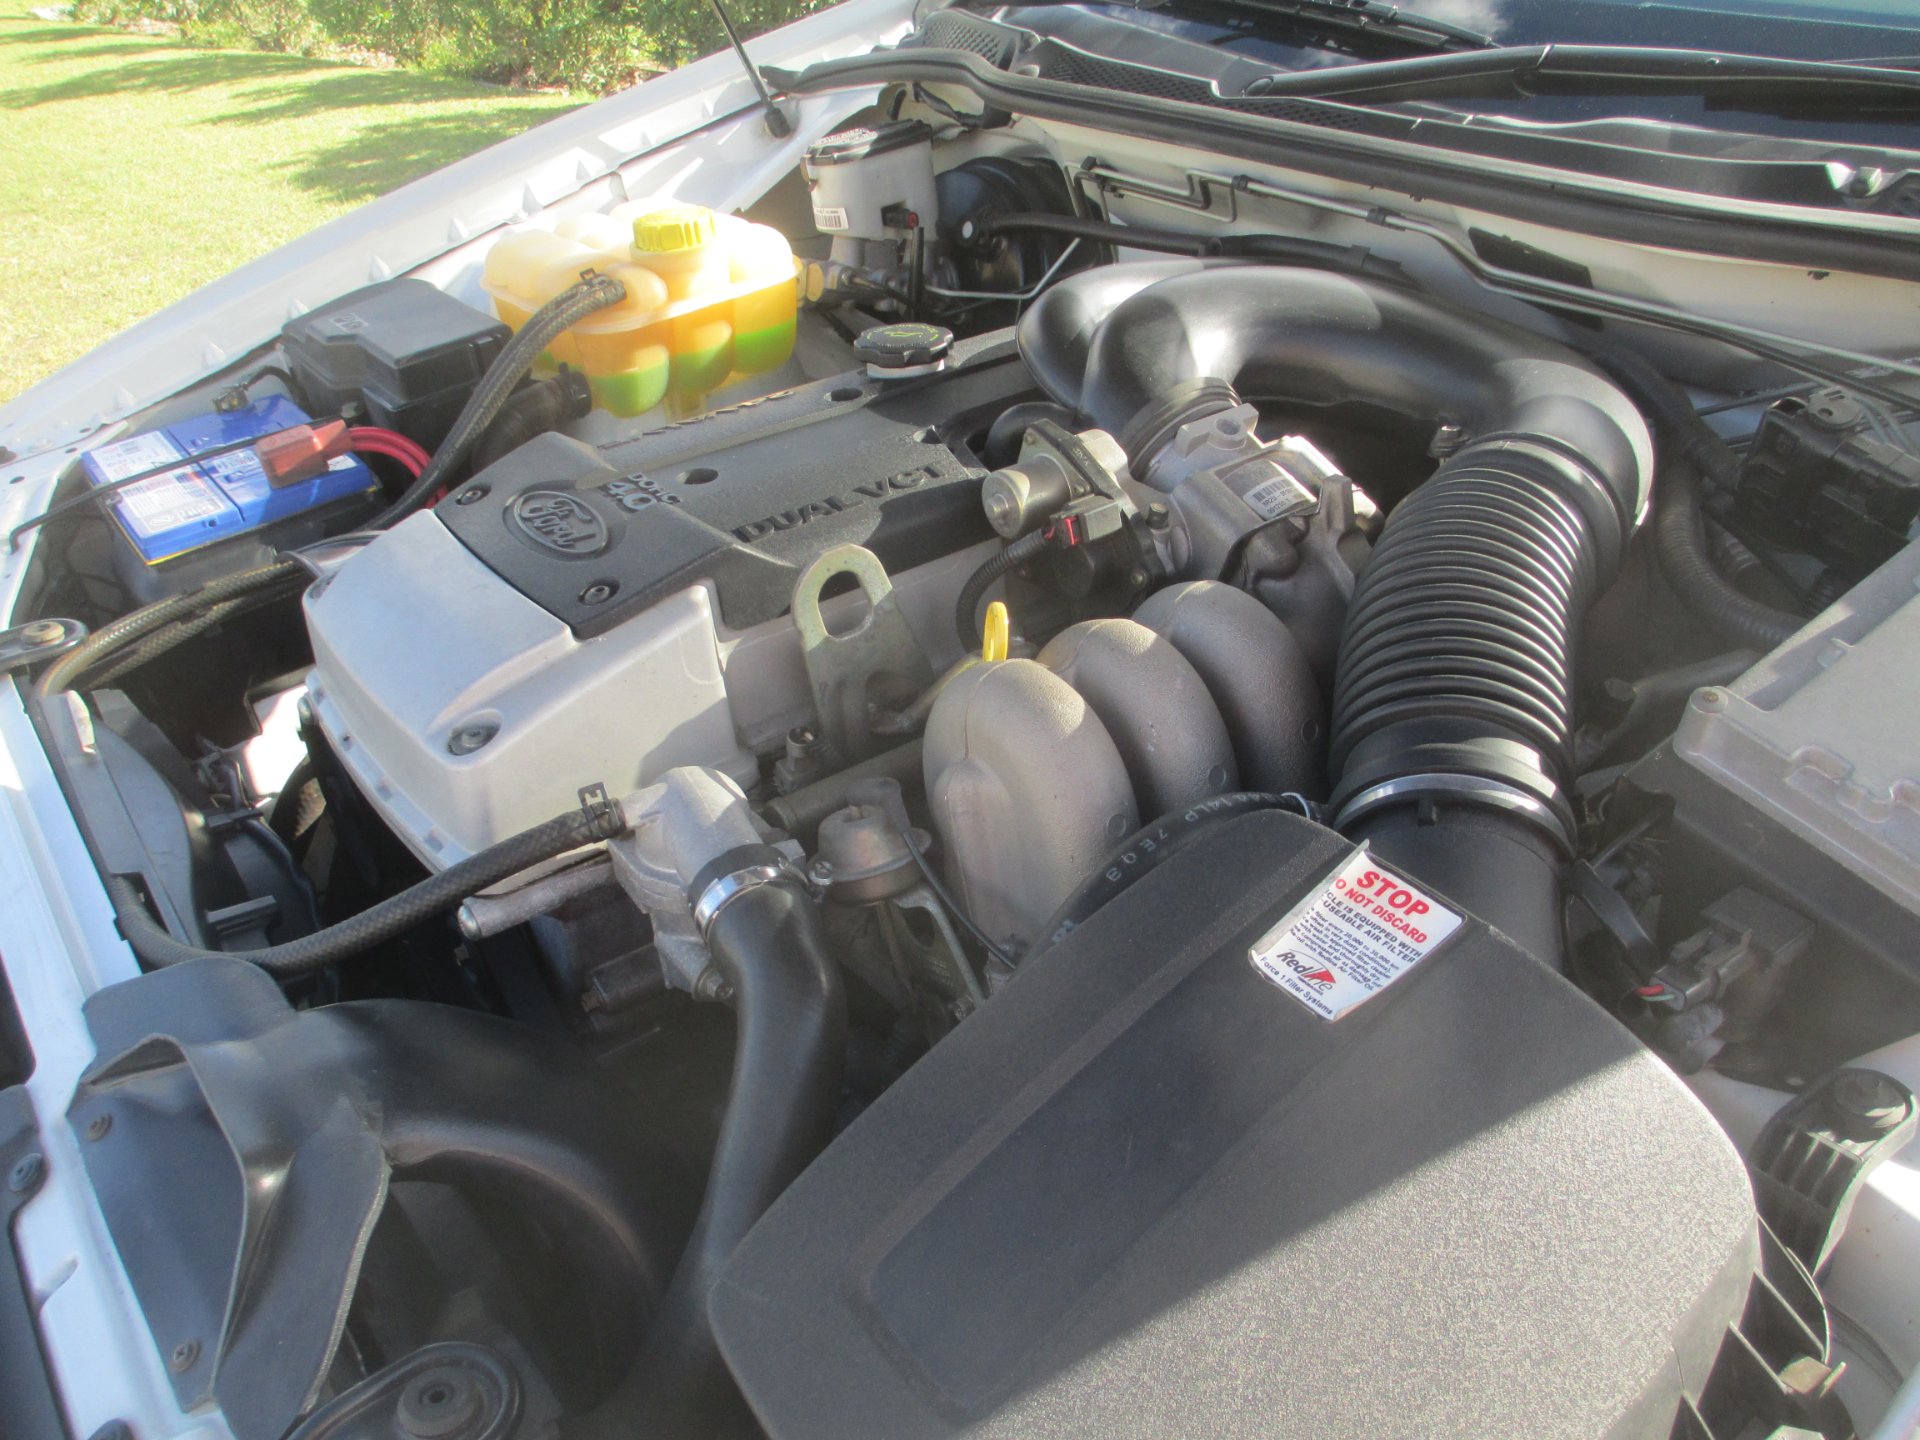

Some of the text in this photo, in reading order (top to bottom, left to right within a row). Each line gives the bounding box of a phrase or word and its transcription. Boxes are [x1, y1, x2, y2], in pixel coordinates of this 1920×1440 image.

[519, 497, 597, 547] Ford
[731, 495, 864, 543] DUAL
[1335, 878, 1428, 944] O NOT DISCARD
[1356, 870, 1430, 916] STOP
[1343, 905, 1354, 914] IS
[1353, 911, 1398, 943] EQUIPPED
[1398, 940, 1423, 958] WITH
[1363, 929, 1383, 943] AIR
[1381, 940, 1417, 963] FILTER
[1260, 956, 1280, 976] Force
[1284, 977, 1305, 994] Filter
[1303, 990, 1334, 1015] Systems
